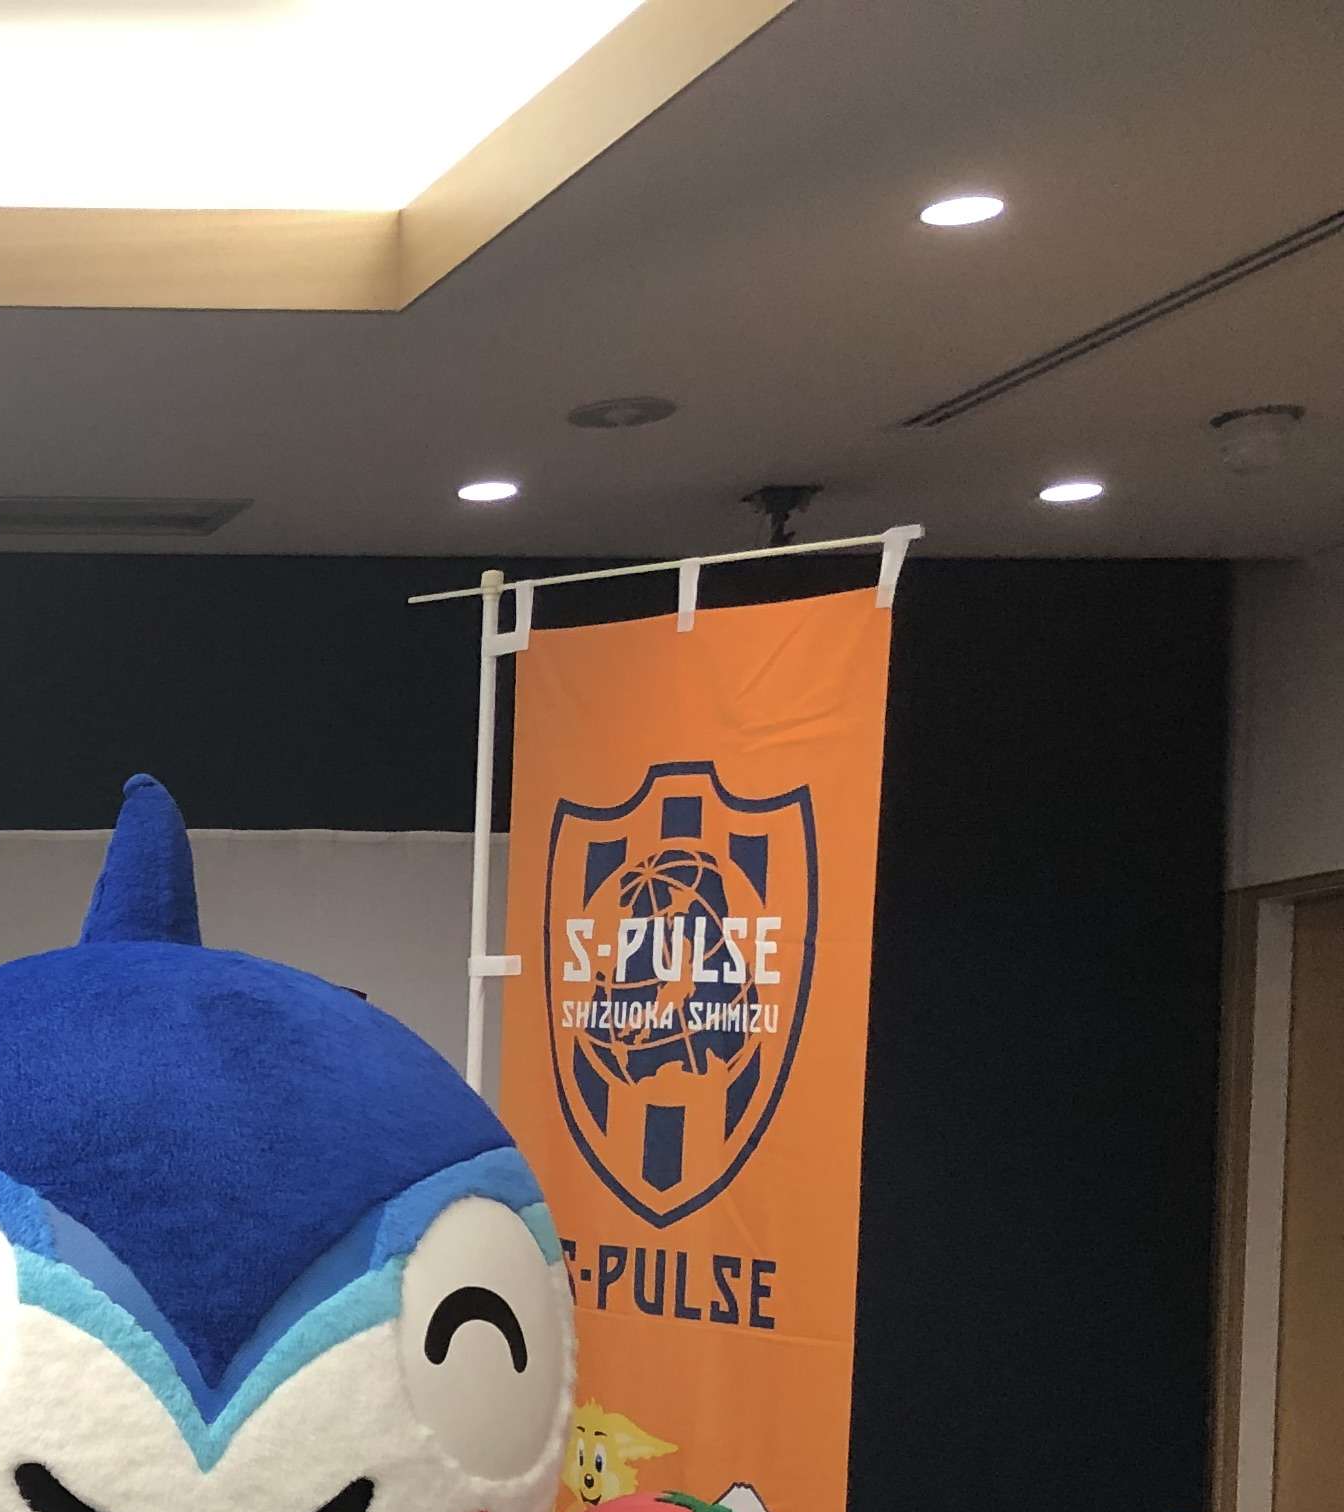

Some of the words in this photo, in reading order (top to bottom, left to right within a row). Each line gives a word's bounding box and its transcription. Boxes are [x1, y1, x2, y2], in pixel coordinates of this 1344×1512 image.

[562, 916, 782, 985] S-PULSE
[561, 1000, 674, 1030] SHIZUOKA
[687, 1001, 779, 1034] SHIMIZU
